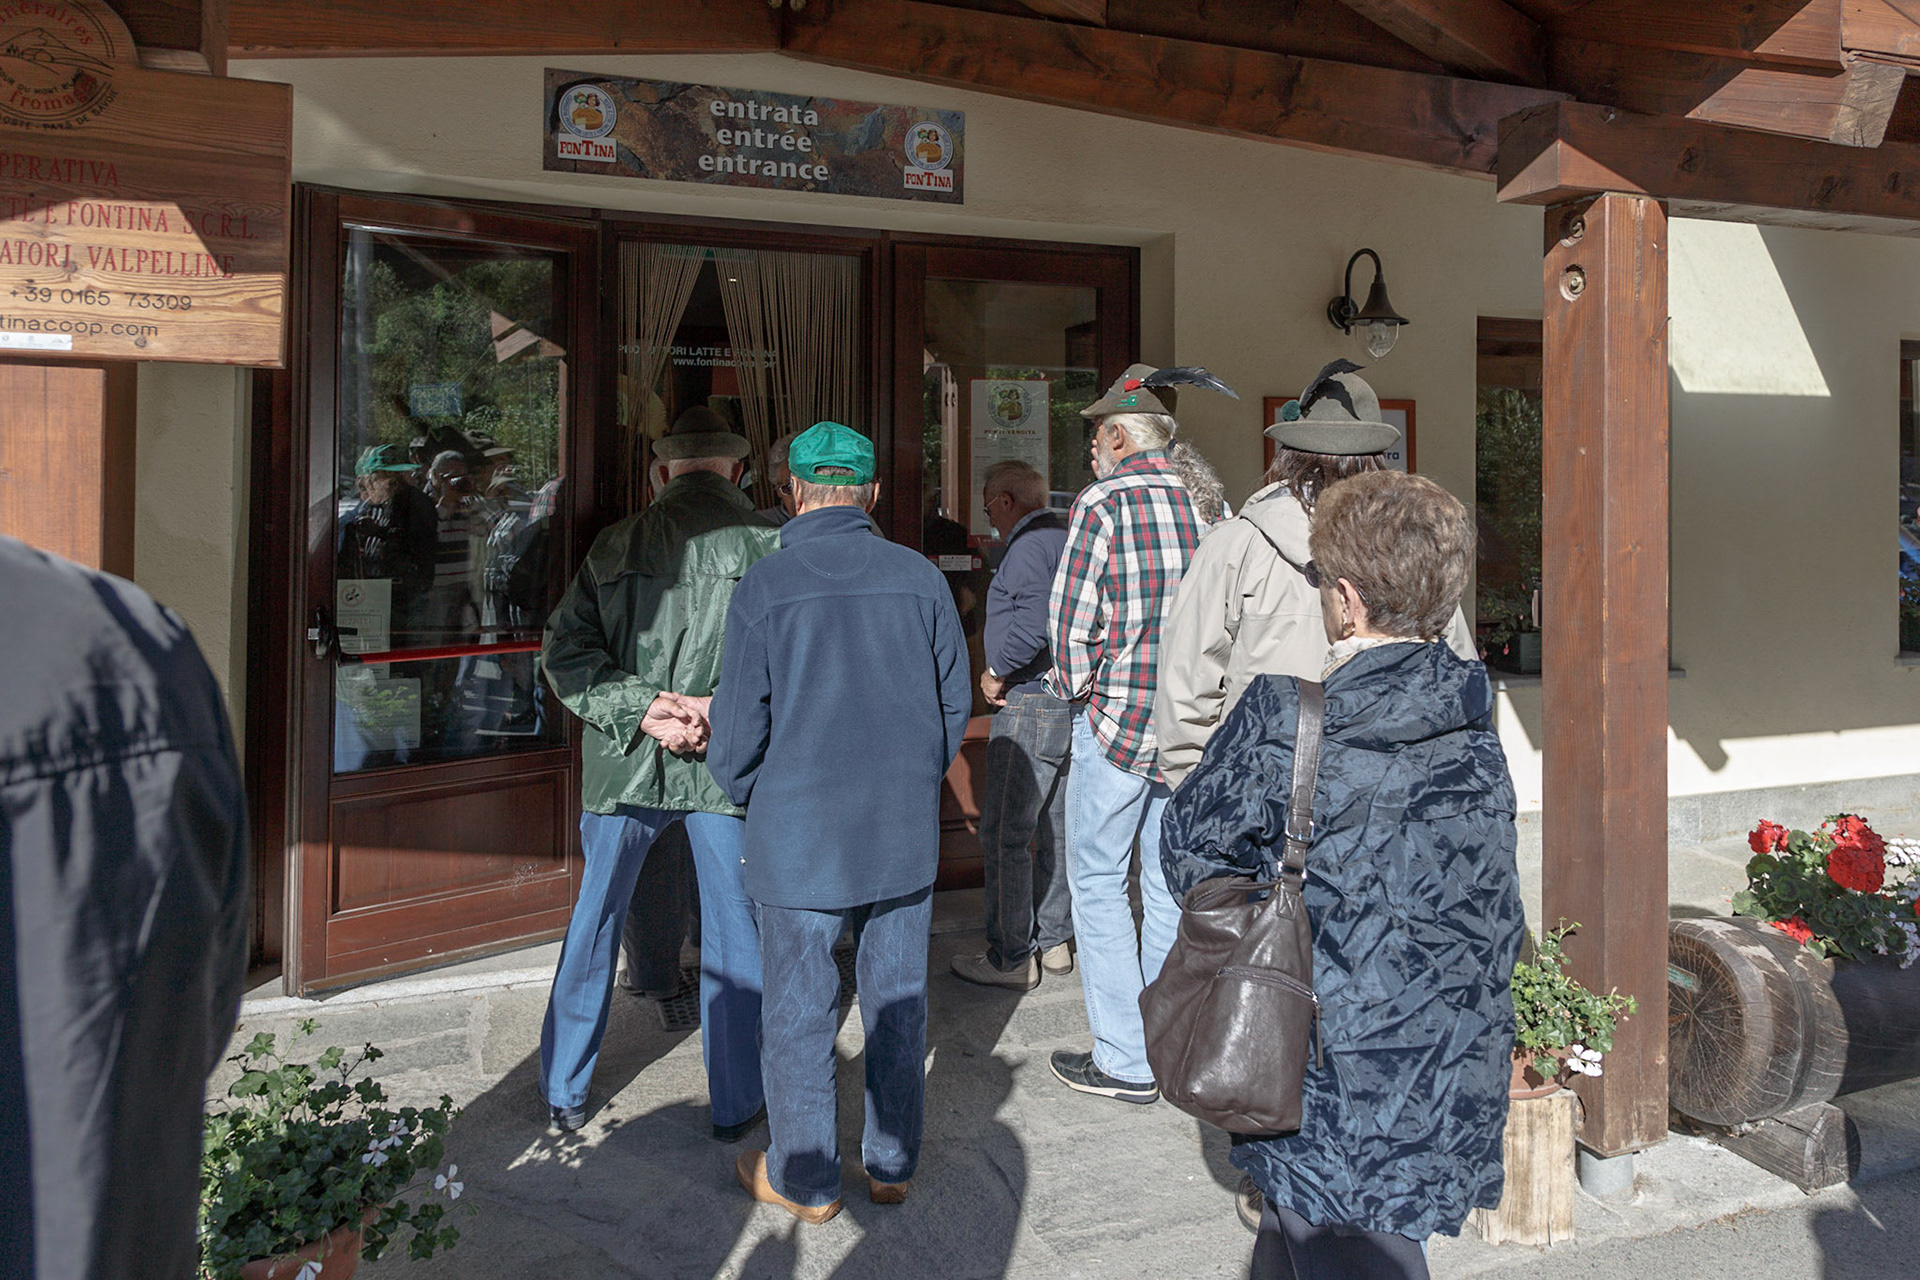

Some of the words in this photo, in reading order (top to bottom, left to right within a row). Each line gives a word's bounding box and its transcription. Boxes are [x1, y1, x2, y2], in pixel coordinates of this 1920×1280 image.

[710, 99, 819, 126] entrata
[716, 128, 812, 153] entrée
[698, 154, 829, 181] entrance
[45, 199, 57, 224] E
[67, 202, 168, 233] FONTINA
[87, 245, 235, 279] VALPELLINE
[10, 286, 52, 303] +39
[61, 288, 111, 306] 0165
[125, 292, 193, 311] 73309
[689, 346, 722, 357] LATTE
[724, 348, 731, 357] E
